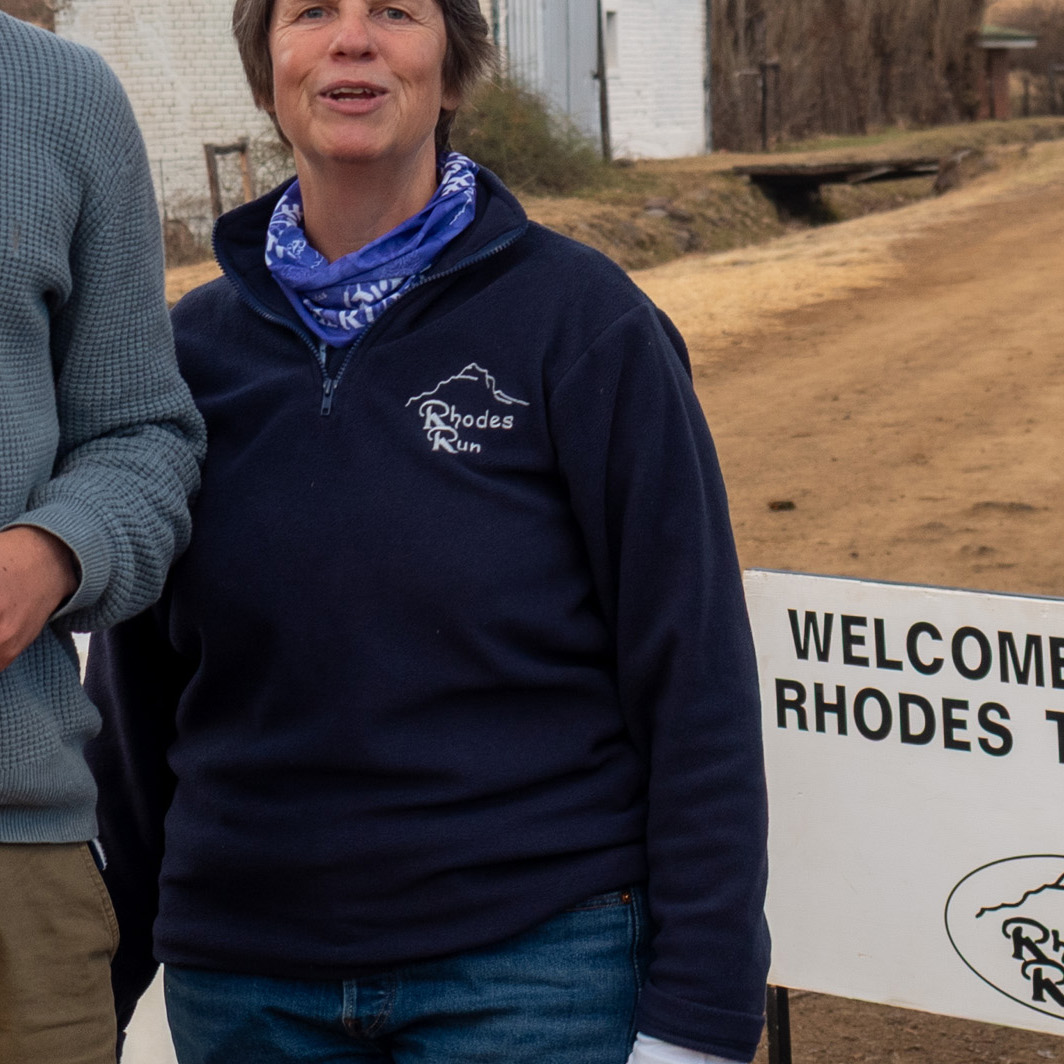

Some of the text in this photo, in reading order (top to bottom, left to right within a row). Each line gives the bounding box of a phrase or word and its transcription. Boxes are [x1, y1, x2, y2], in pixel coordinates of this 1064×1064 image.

[419, 399, 515, 430] Rhodes
[427, 426, 482, 454] Run
[774, 678, 1014, 757] RHODES
